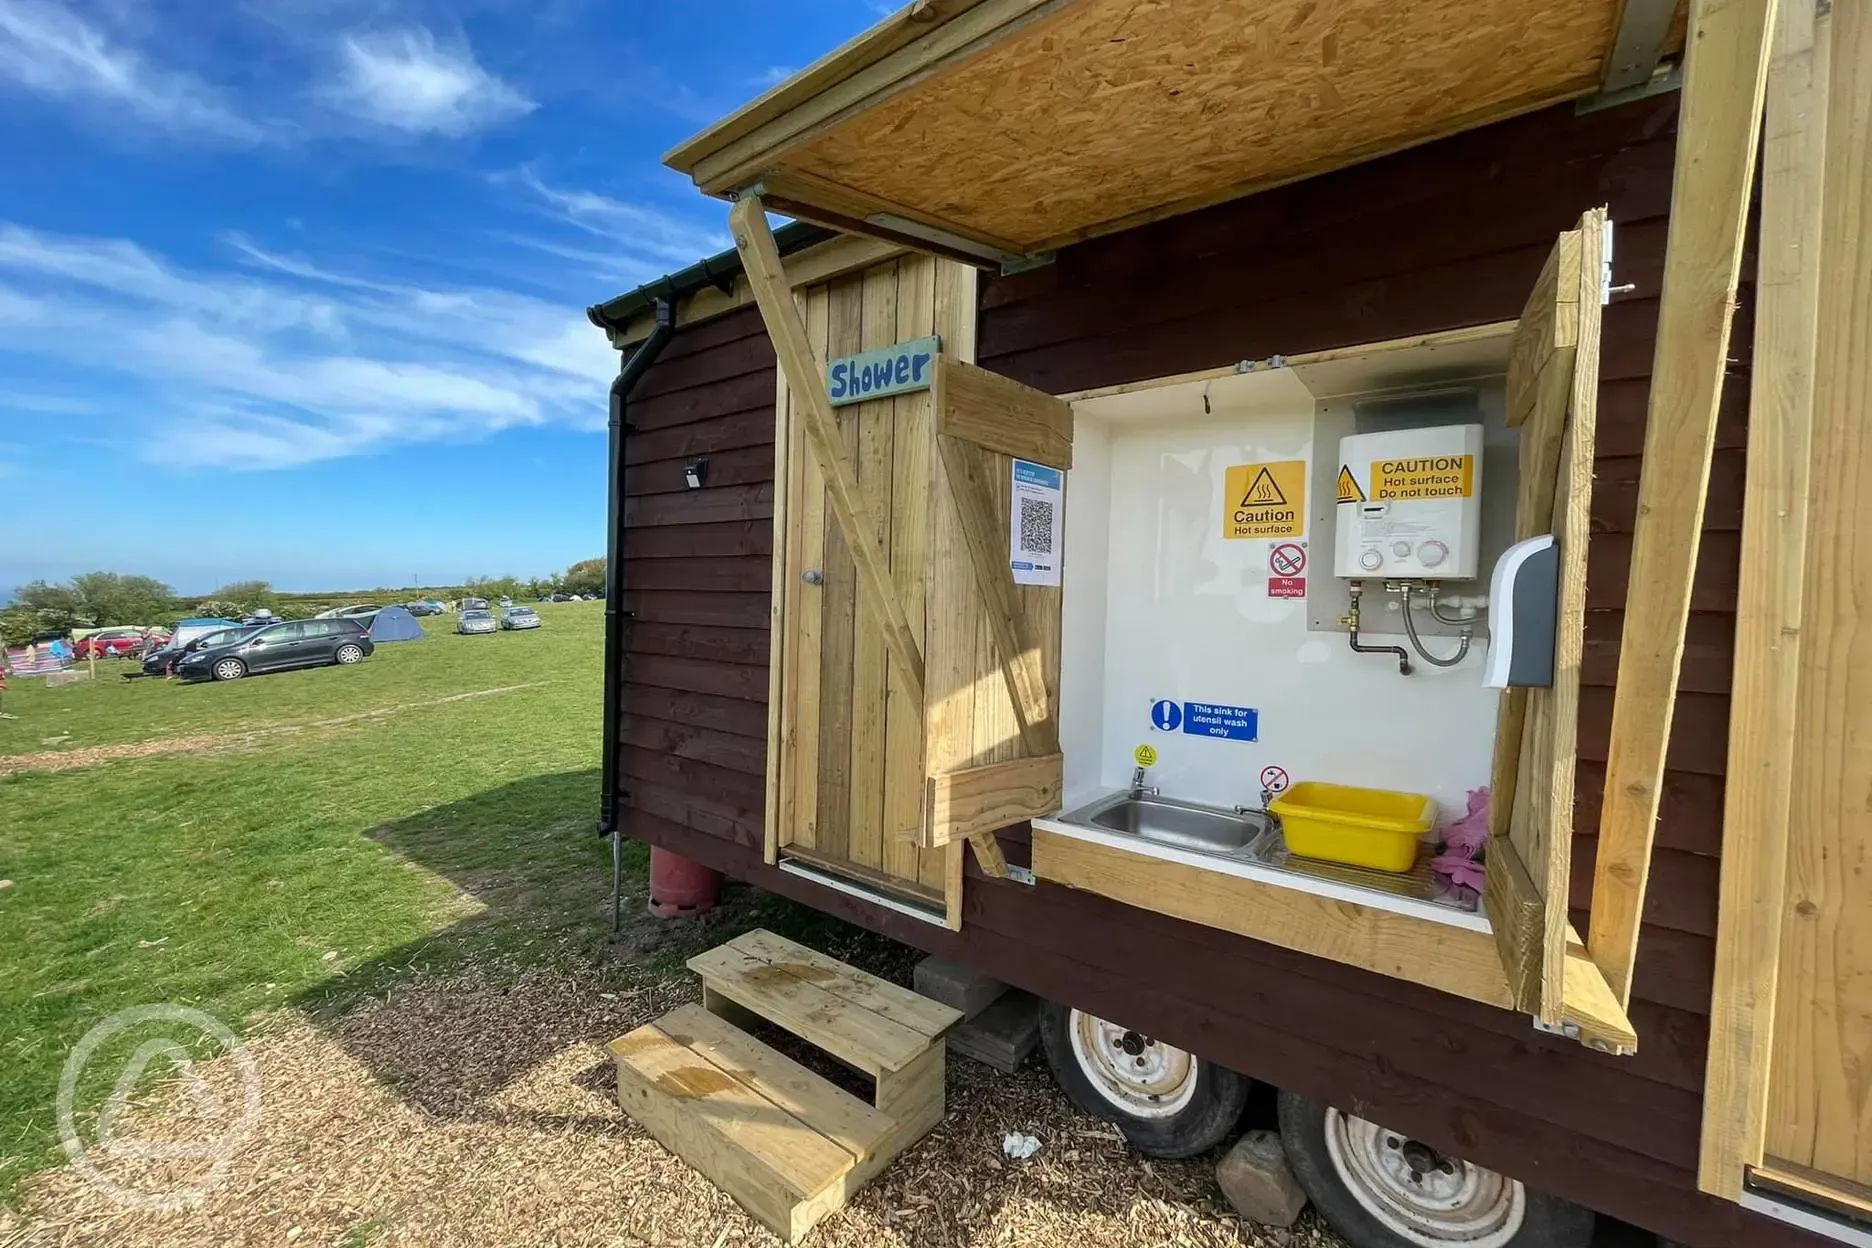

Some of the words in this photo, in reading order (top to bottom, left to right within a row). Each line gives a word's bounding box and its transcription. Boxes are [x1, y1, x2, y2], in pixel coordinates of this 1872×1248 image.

[831, 353, 930, 397] Shower
[1382, 458, 1462, 474] CAUTION
[1384, 477, 1405, 487] Hot
[1409, 475, 1459, 485] surface
[1379, 489, 1397, 498] Do
[1400, 488, 1421, 497] not
[1425, 486, 1463, 496] touch
[1234, 509, 1294, 523] Caution
[1234, 526, 1251, 535] Hot
[1254, 525, 1293, 534] surface
[1271, 588, 1303, 596] smoking
[1194, 705, 1211, 714] This
[1214, 707, 1232, 715] sink
[1234, 709, 1248, 717] for
[1193, 715, 1221, 724] utensil
[1223, 719, 1248, 727] wash
[1210, 727, 1229, 736] only
